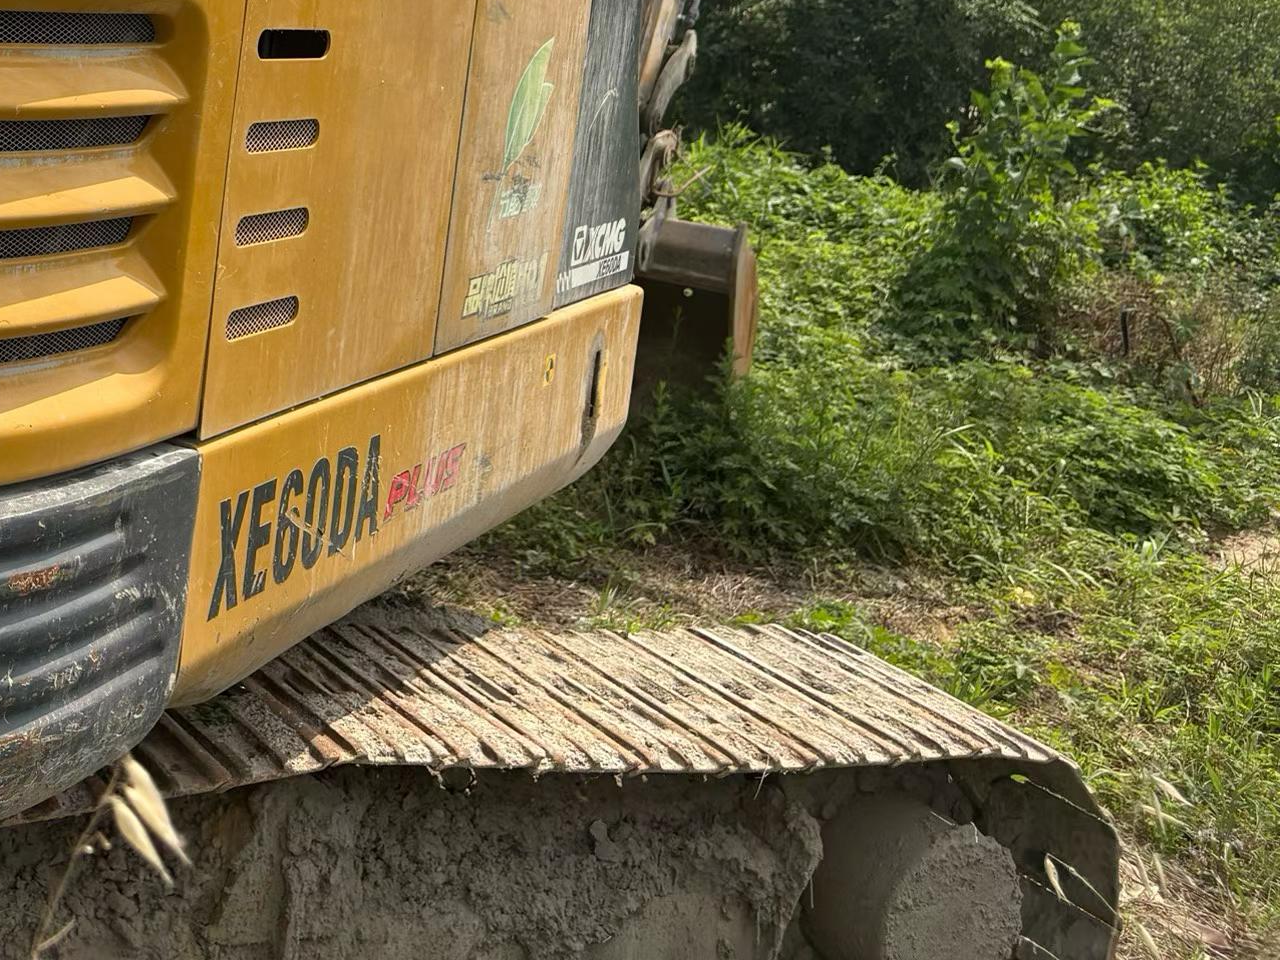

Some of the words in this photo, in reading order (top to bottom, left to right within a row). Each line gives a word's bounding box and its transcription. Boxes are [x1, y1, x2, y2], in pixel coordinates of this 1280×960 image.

[583, 217, 626, 262] XCMG
[207, 434, 381, 622] XE60DA
[383, 442, 466, 523] PLUS
